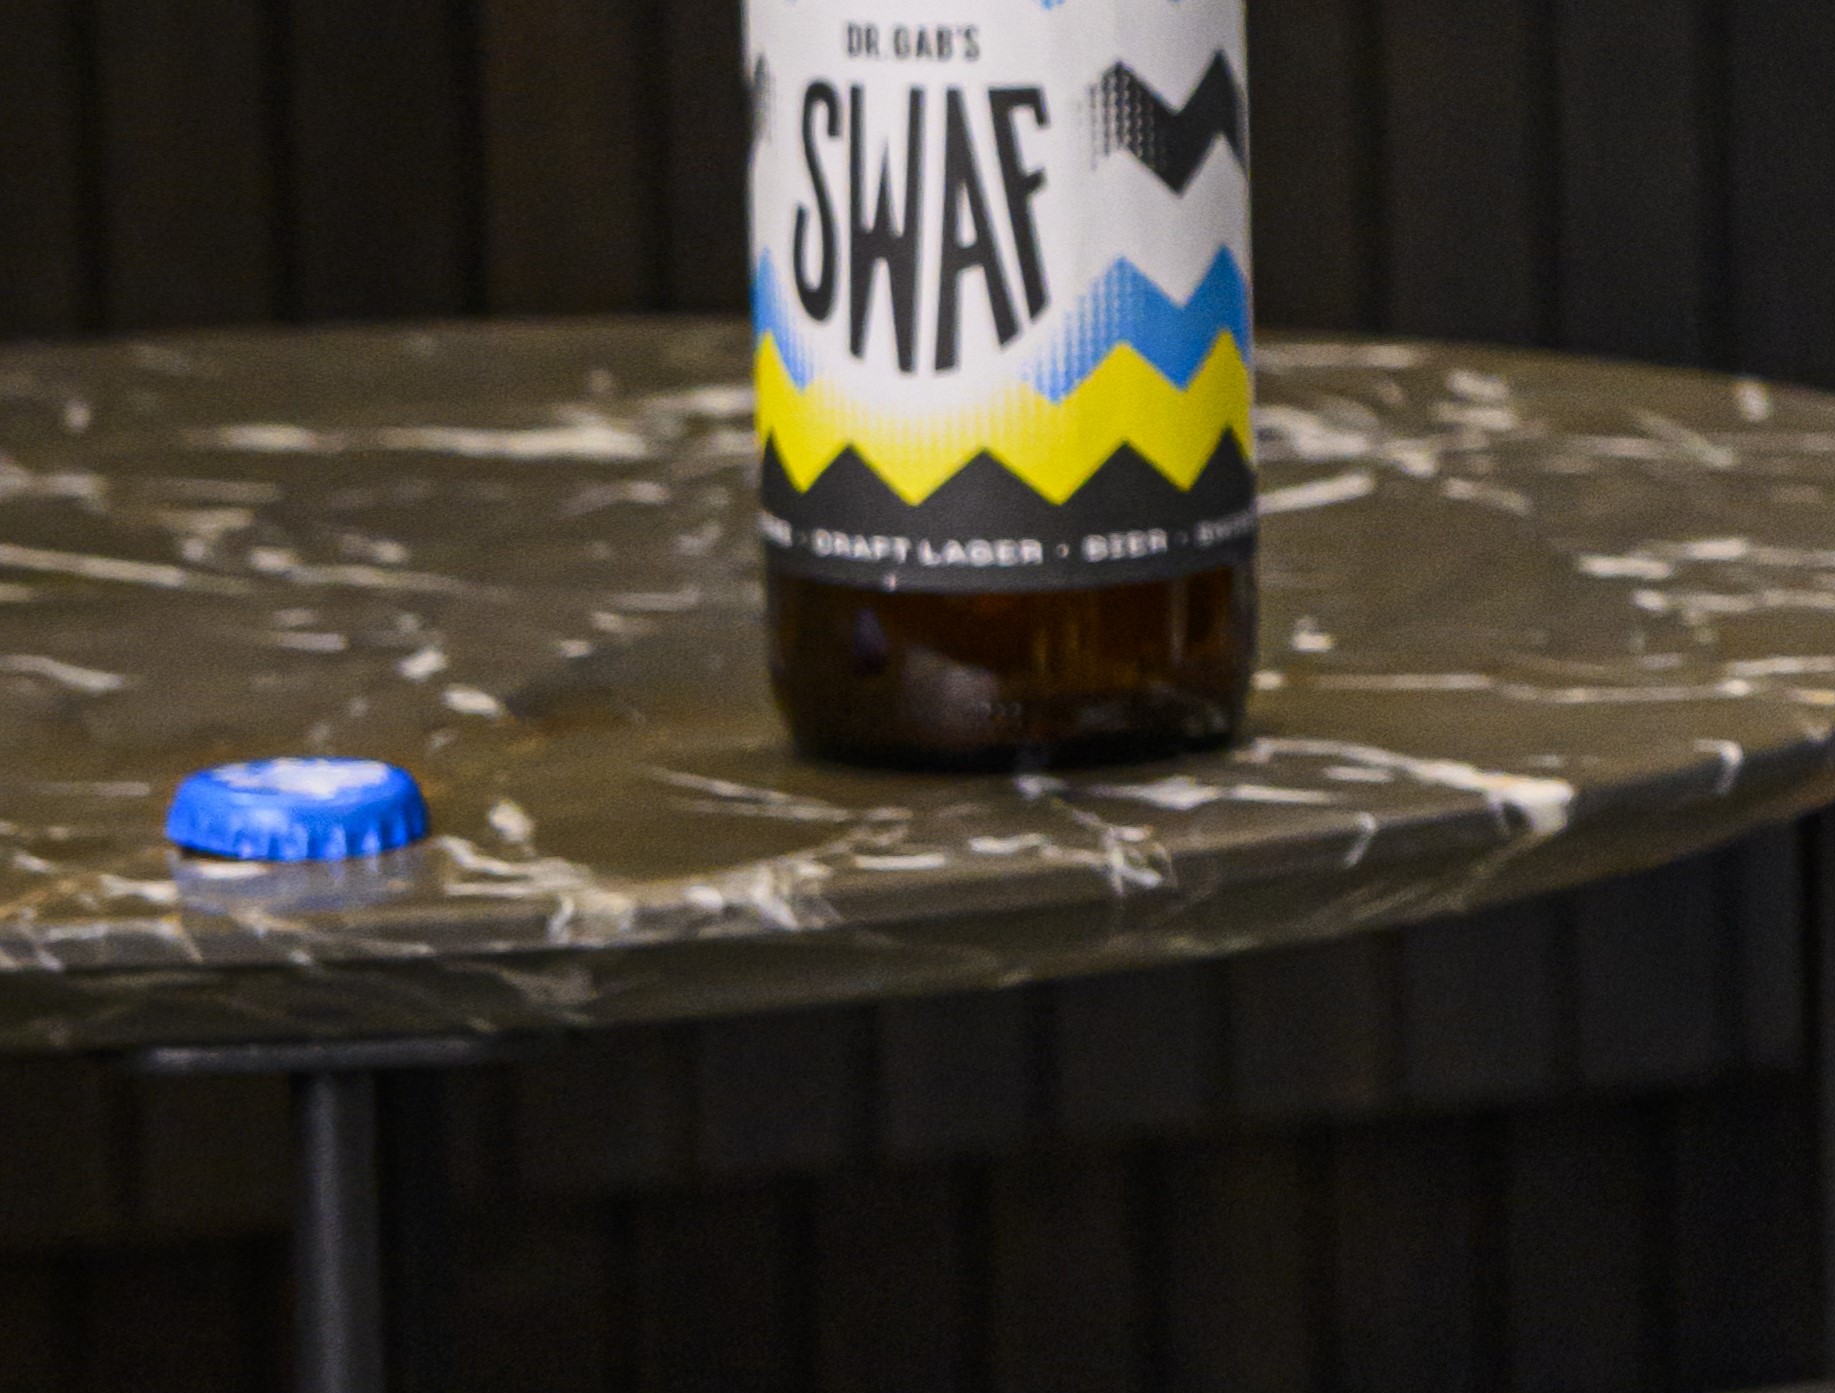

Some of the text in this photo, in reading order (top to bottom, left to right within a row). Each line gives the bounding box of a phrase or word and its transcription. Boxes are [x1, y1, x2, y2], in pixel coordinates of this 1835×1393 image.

[893, 23, 981, 62] GAB'S
[792, 80, 1049, 374] SWAF
[917, 537, 1043, 568] LAGER
[1082, 529, 1168, 562] BIER
